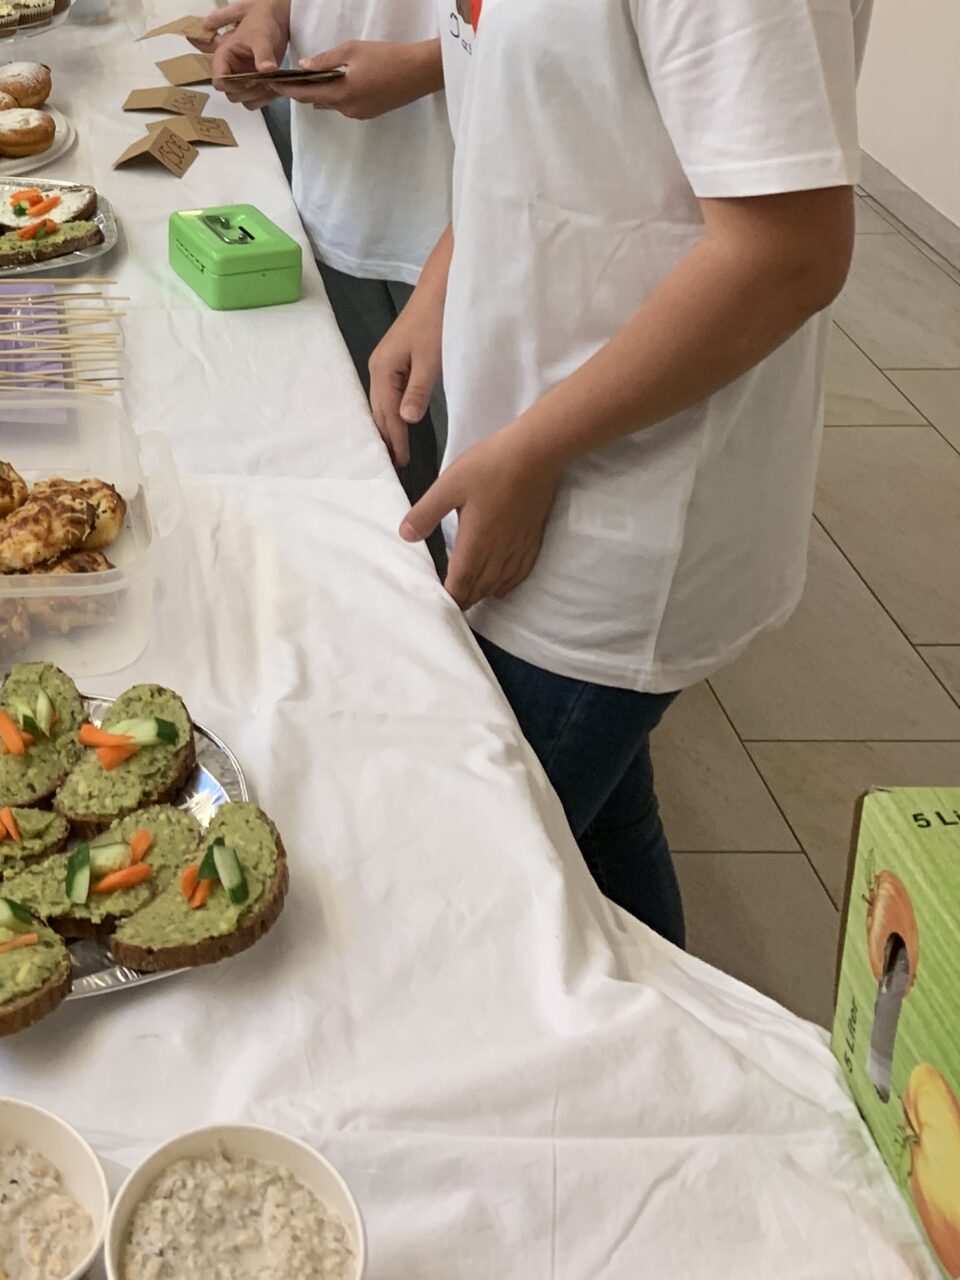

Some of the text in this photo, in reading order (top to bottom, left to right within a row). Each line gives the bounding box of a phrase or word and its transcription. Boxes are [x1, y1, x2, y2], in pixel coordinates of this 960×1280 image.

[912, 812, 932, 829] 5
[843, 995, 858, 1074] 5 Liter
